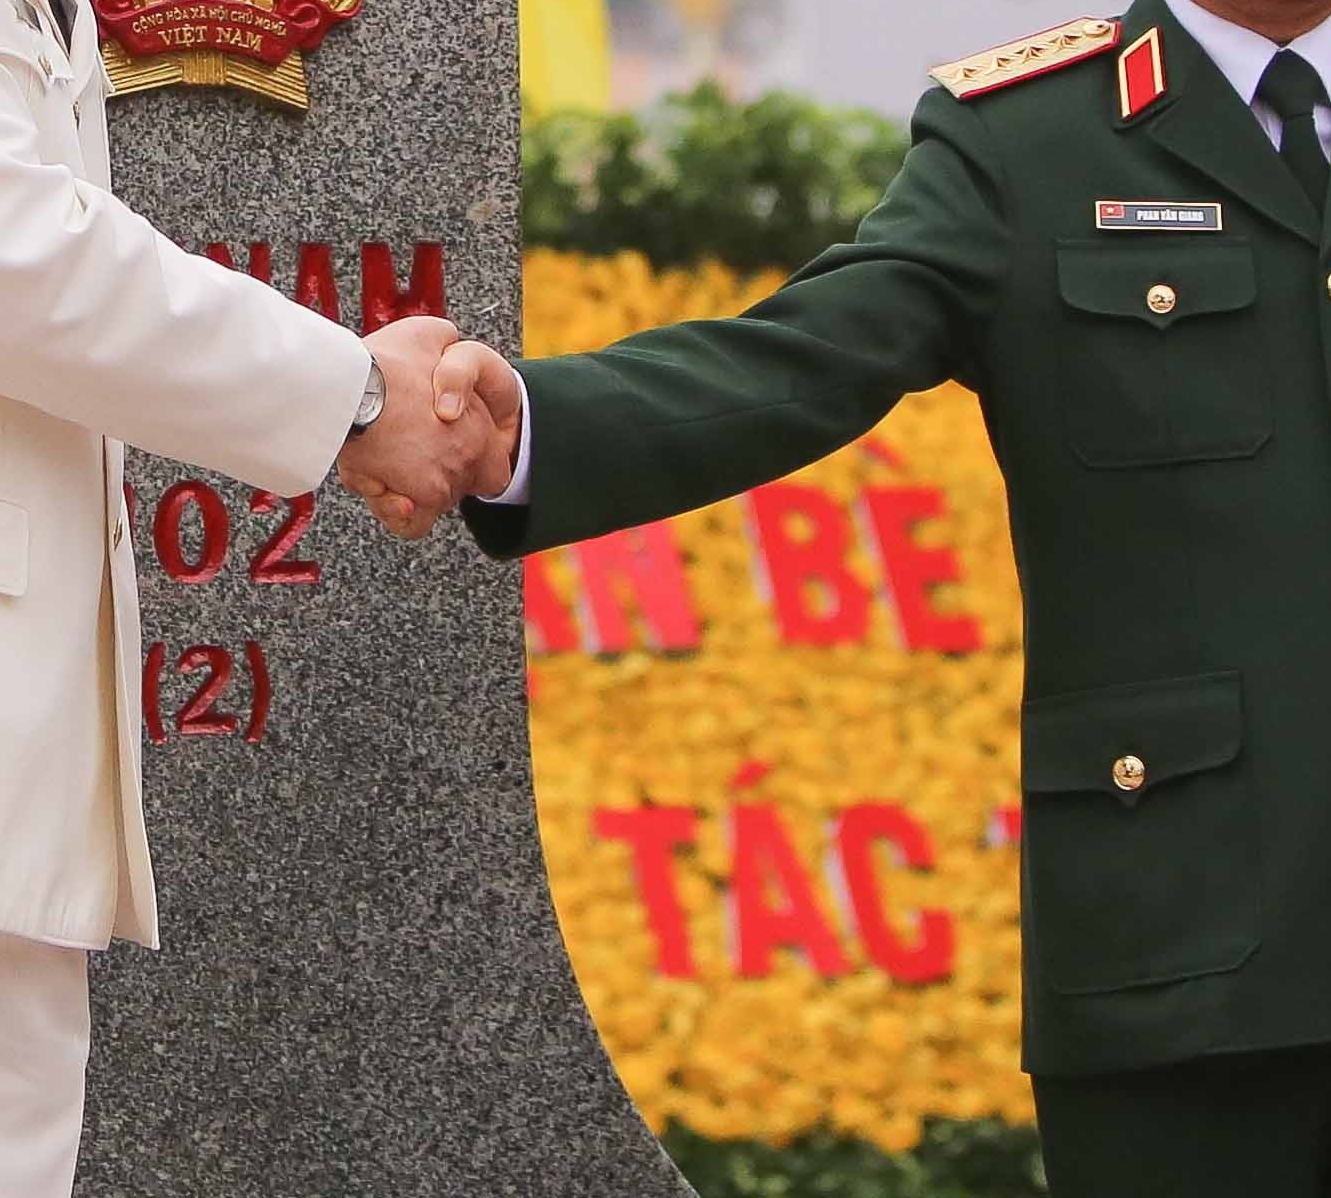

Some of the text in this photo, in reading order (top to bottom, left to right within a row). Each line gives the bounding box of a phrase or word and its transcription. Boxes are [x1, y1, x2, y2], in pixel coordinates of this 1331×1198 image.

[132, 13, 164, 34] CỘNG
[166, 7, 190, 20] HÒA
[190, 5, 207, 19] XÃ
[209, 5, 229, 22] HỘI
[230, 8, 254, 24] CHỦ
[158, 24, 263, 51] VIỆT NAM
[124, 481, 320, 584] 02
[748, 436, 986, 653] BÈ
[142, 641, 271, 745] (2)
[591, 758, 958, 986] TÁC
